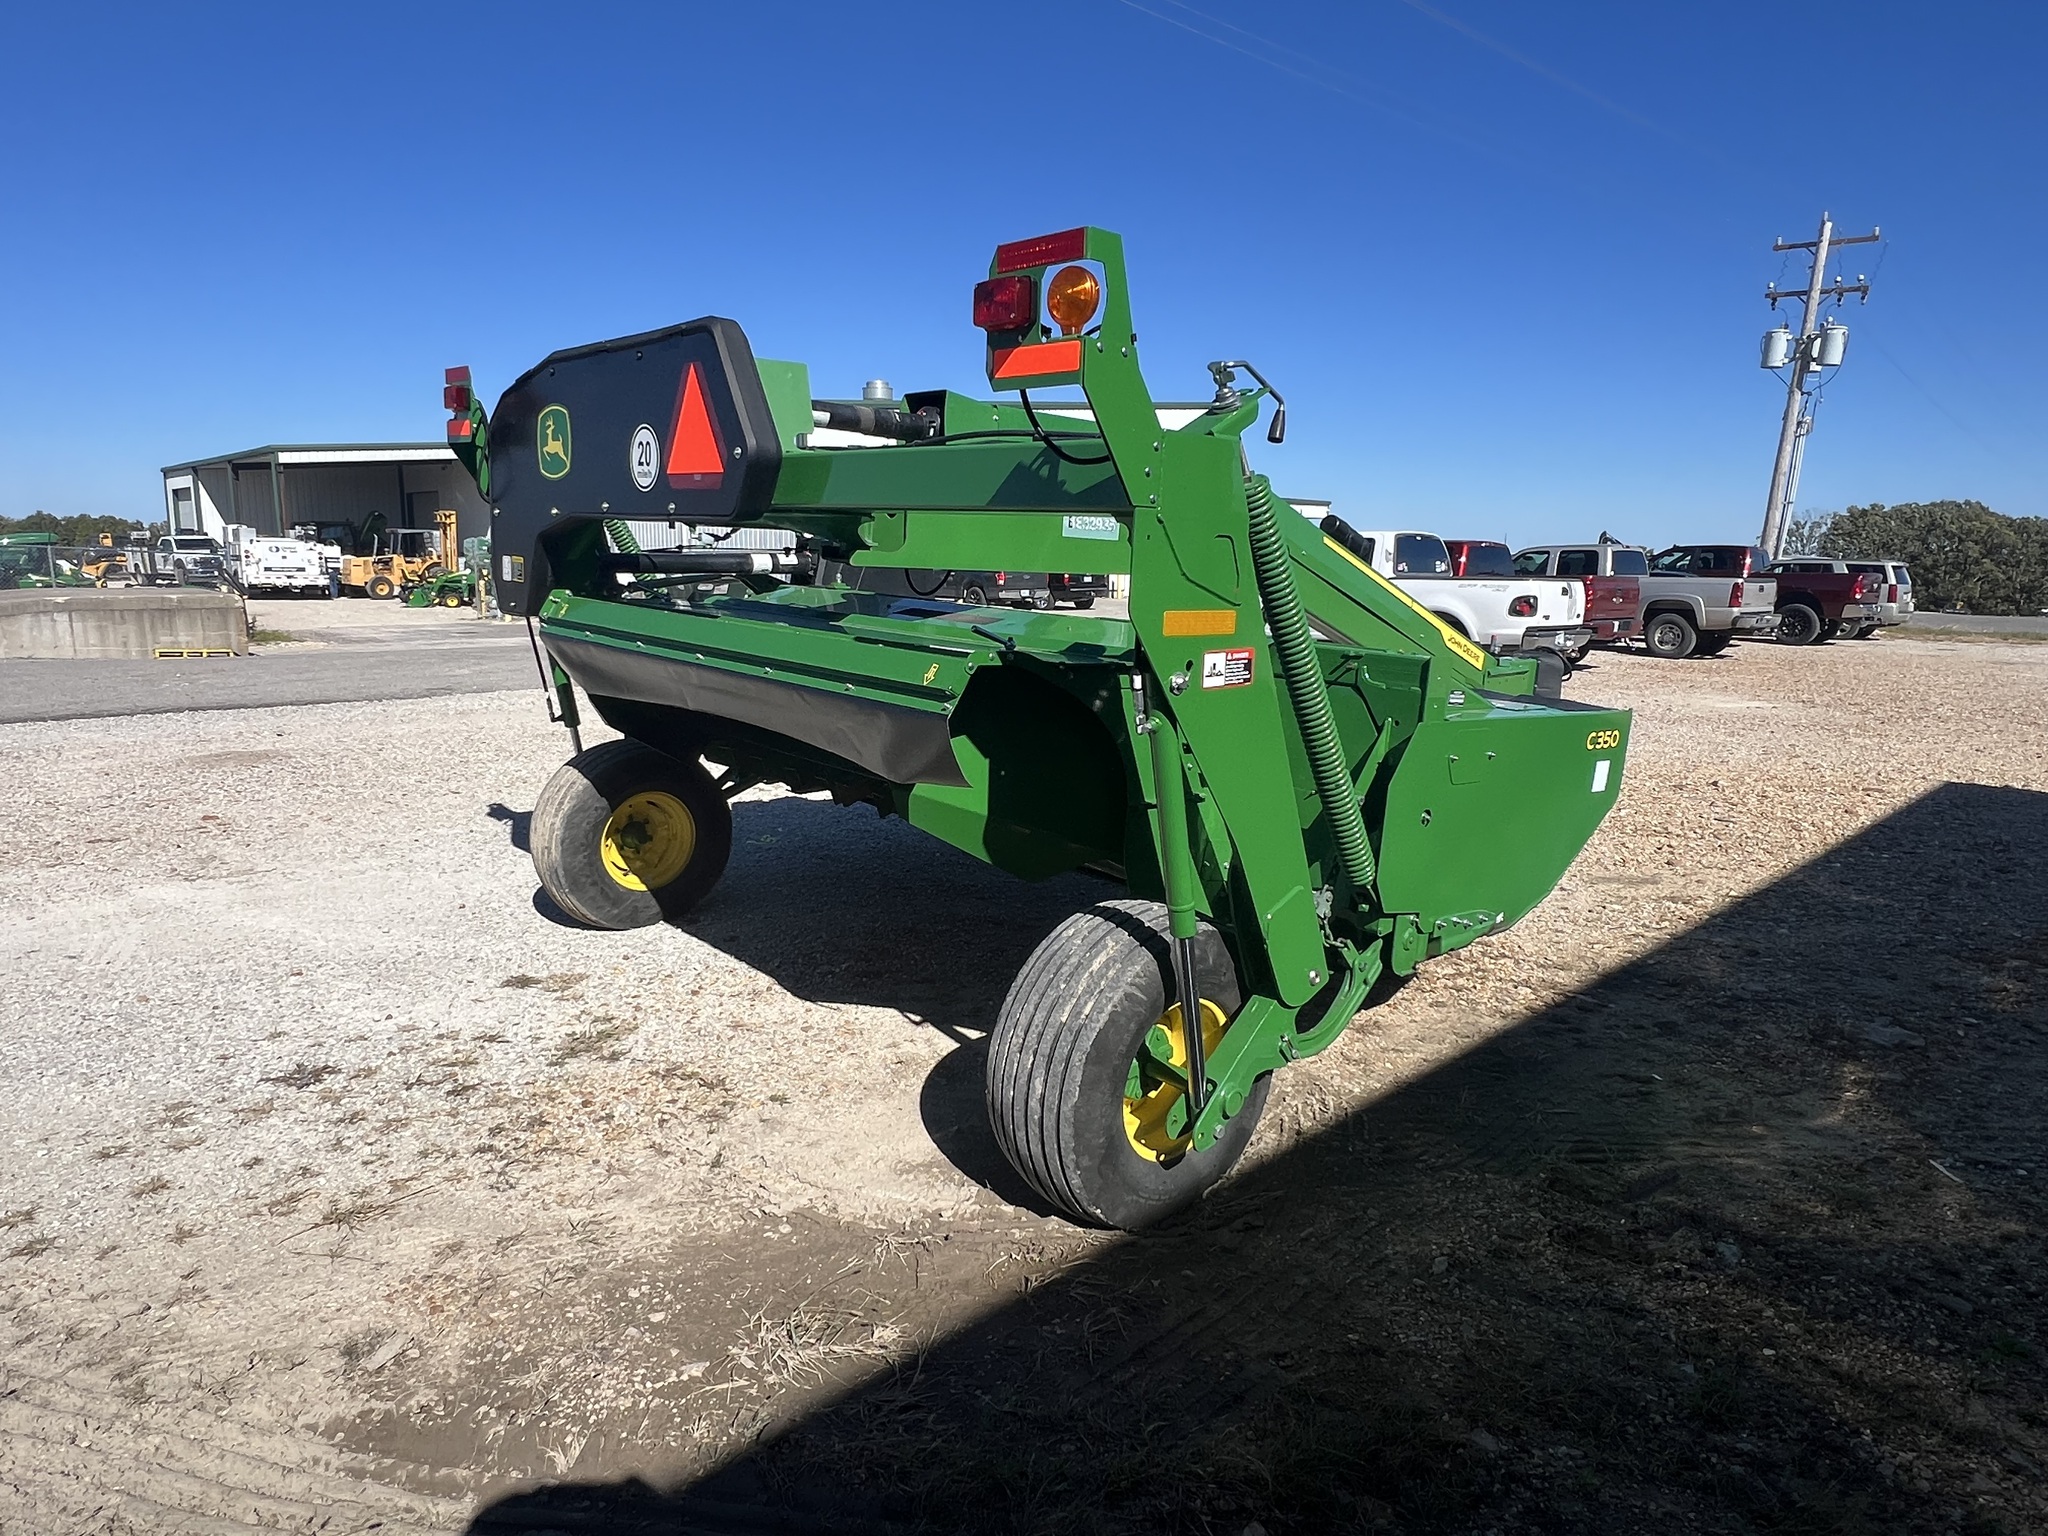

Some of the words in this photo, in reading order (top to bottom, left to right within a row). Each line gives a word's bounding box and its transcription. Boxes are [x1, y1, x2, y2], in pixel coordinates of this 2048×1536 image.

[637, 440, 652, 467] 20
[1447, 634, 1463, 650] JOHN
[1462, 644, 1481, 664] DEERE
[1586, 729, 1620, 751] C350
